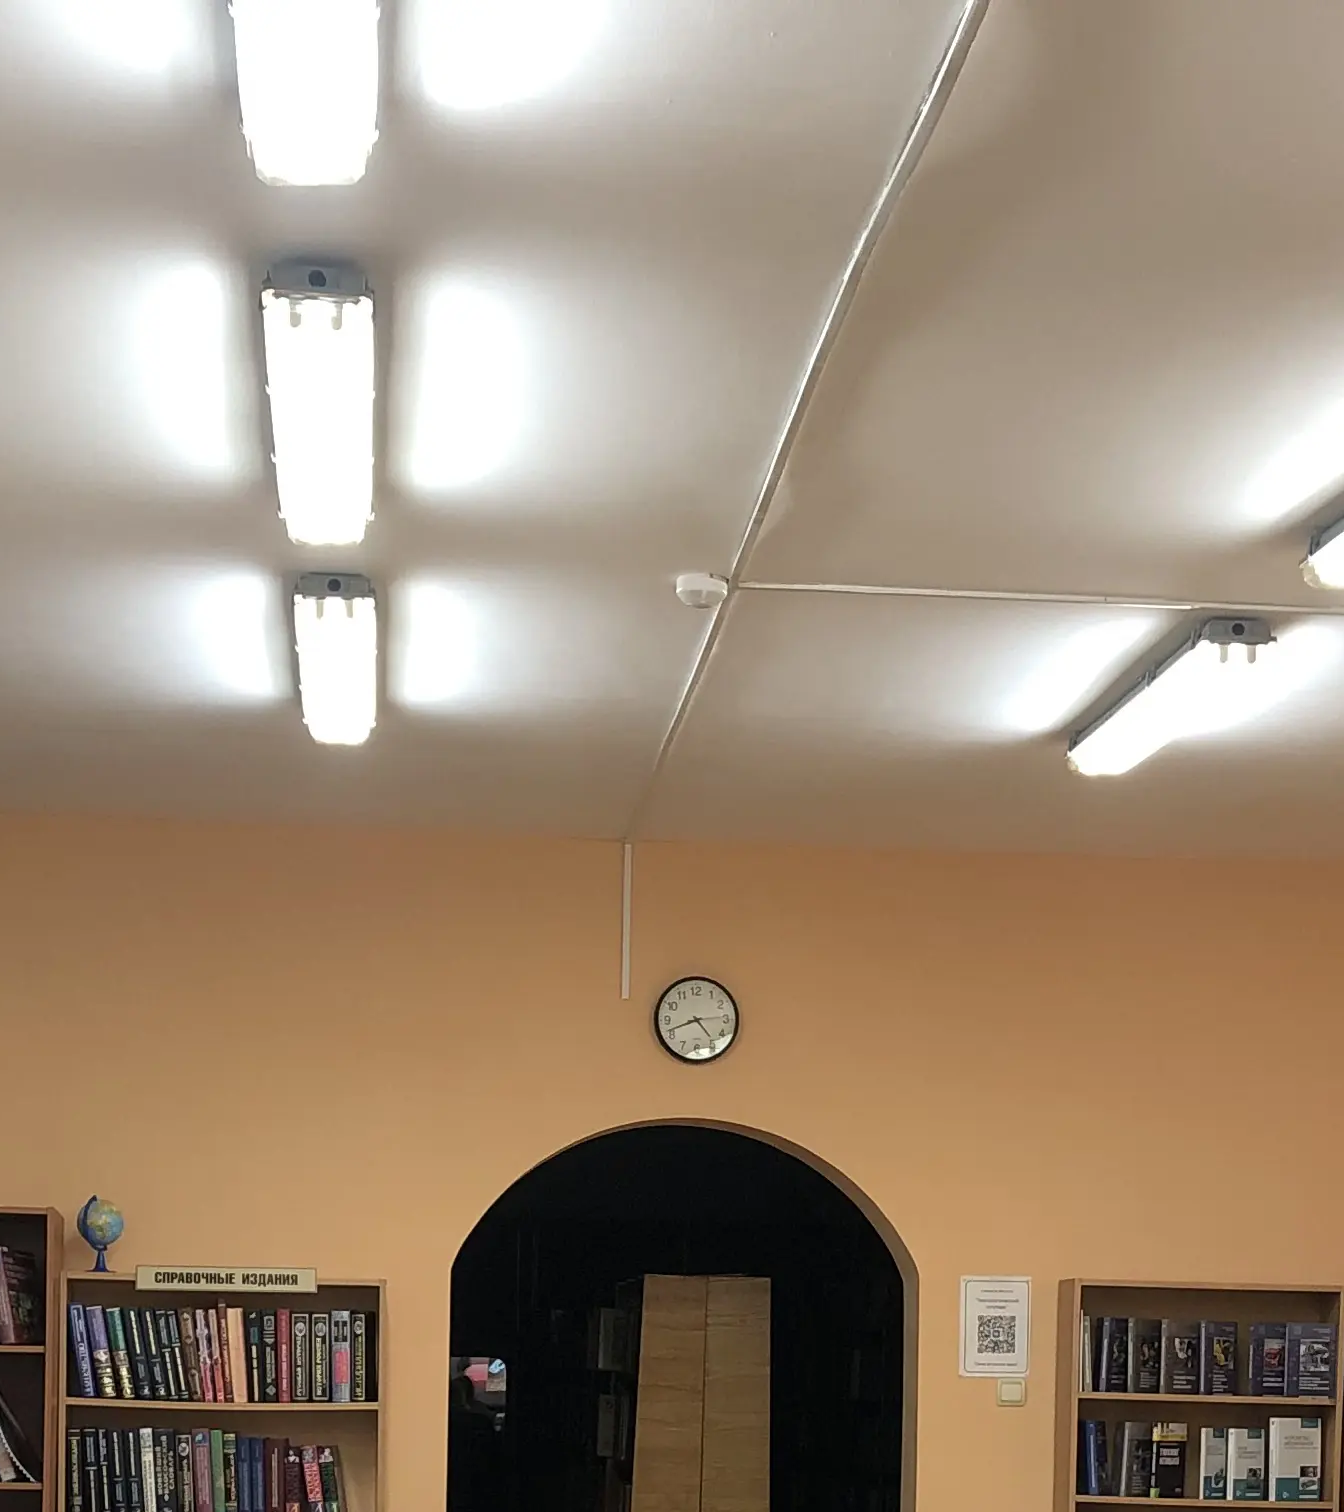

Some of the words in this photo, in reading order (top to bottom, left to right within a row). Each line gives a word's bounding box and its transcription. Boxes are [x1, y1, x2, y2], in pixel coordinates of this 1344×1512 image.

[677, 990, 686, 1000] 11
[690, 986, 702, 997] 12
[709, 990, 714, 1000] 1
[717, 999, 724, 1010] 2
[664, 1015, 671, 1025] 9
[722, 1014, 730, 1024] 3
[718, 1028, 726, 1038] 4
[679, 1040, 687, 1051] 7
[154, 1271, 235, 1285] СПРАВОЧНЫЕ
[241, 1273, 299, 1287] ИЗДАНИЯ
[155, 1446, 163, 1495] НОВЕЙШИЙ
[160, 1435, 169, 1502] ФИЛОСОФСКИЙ
